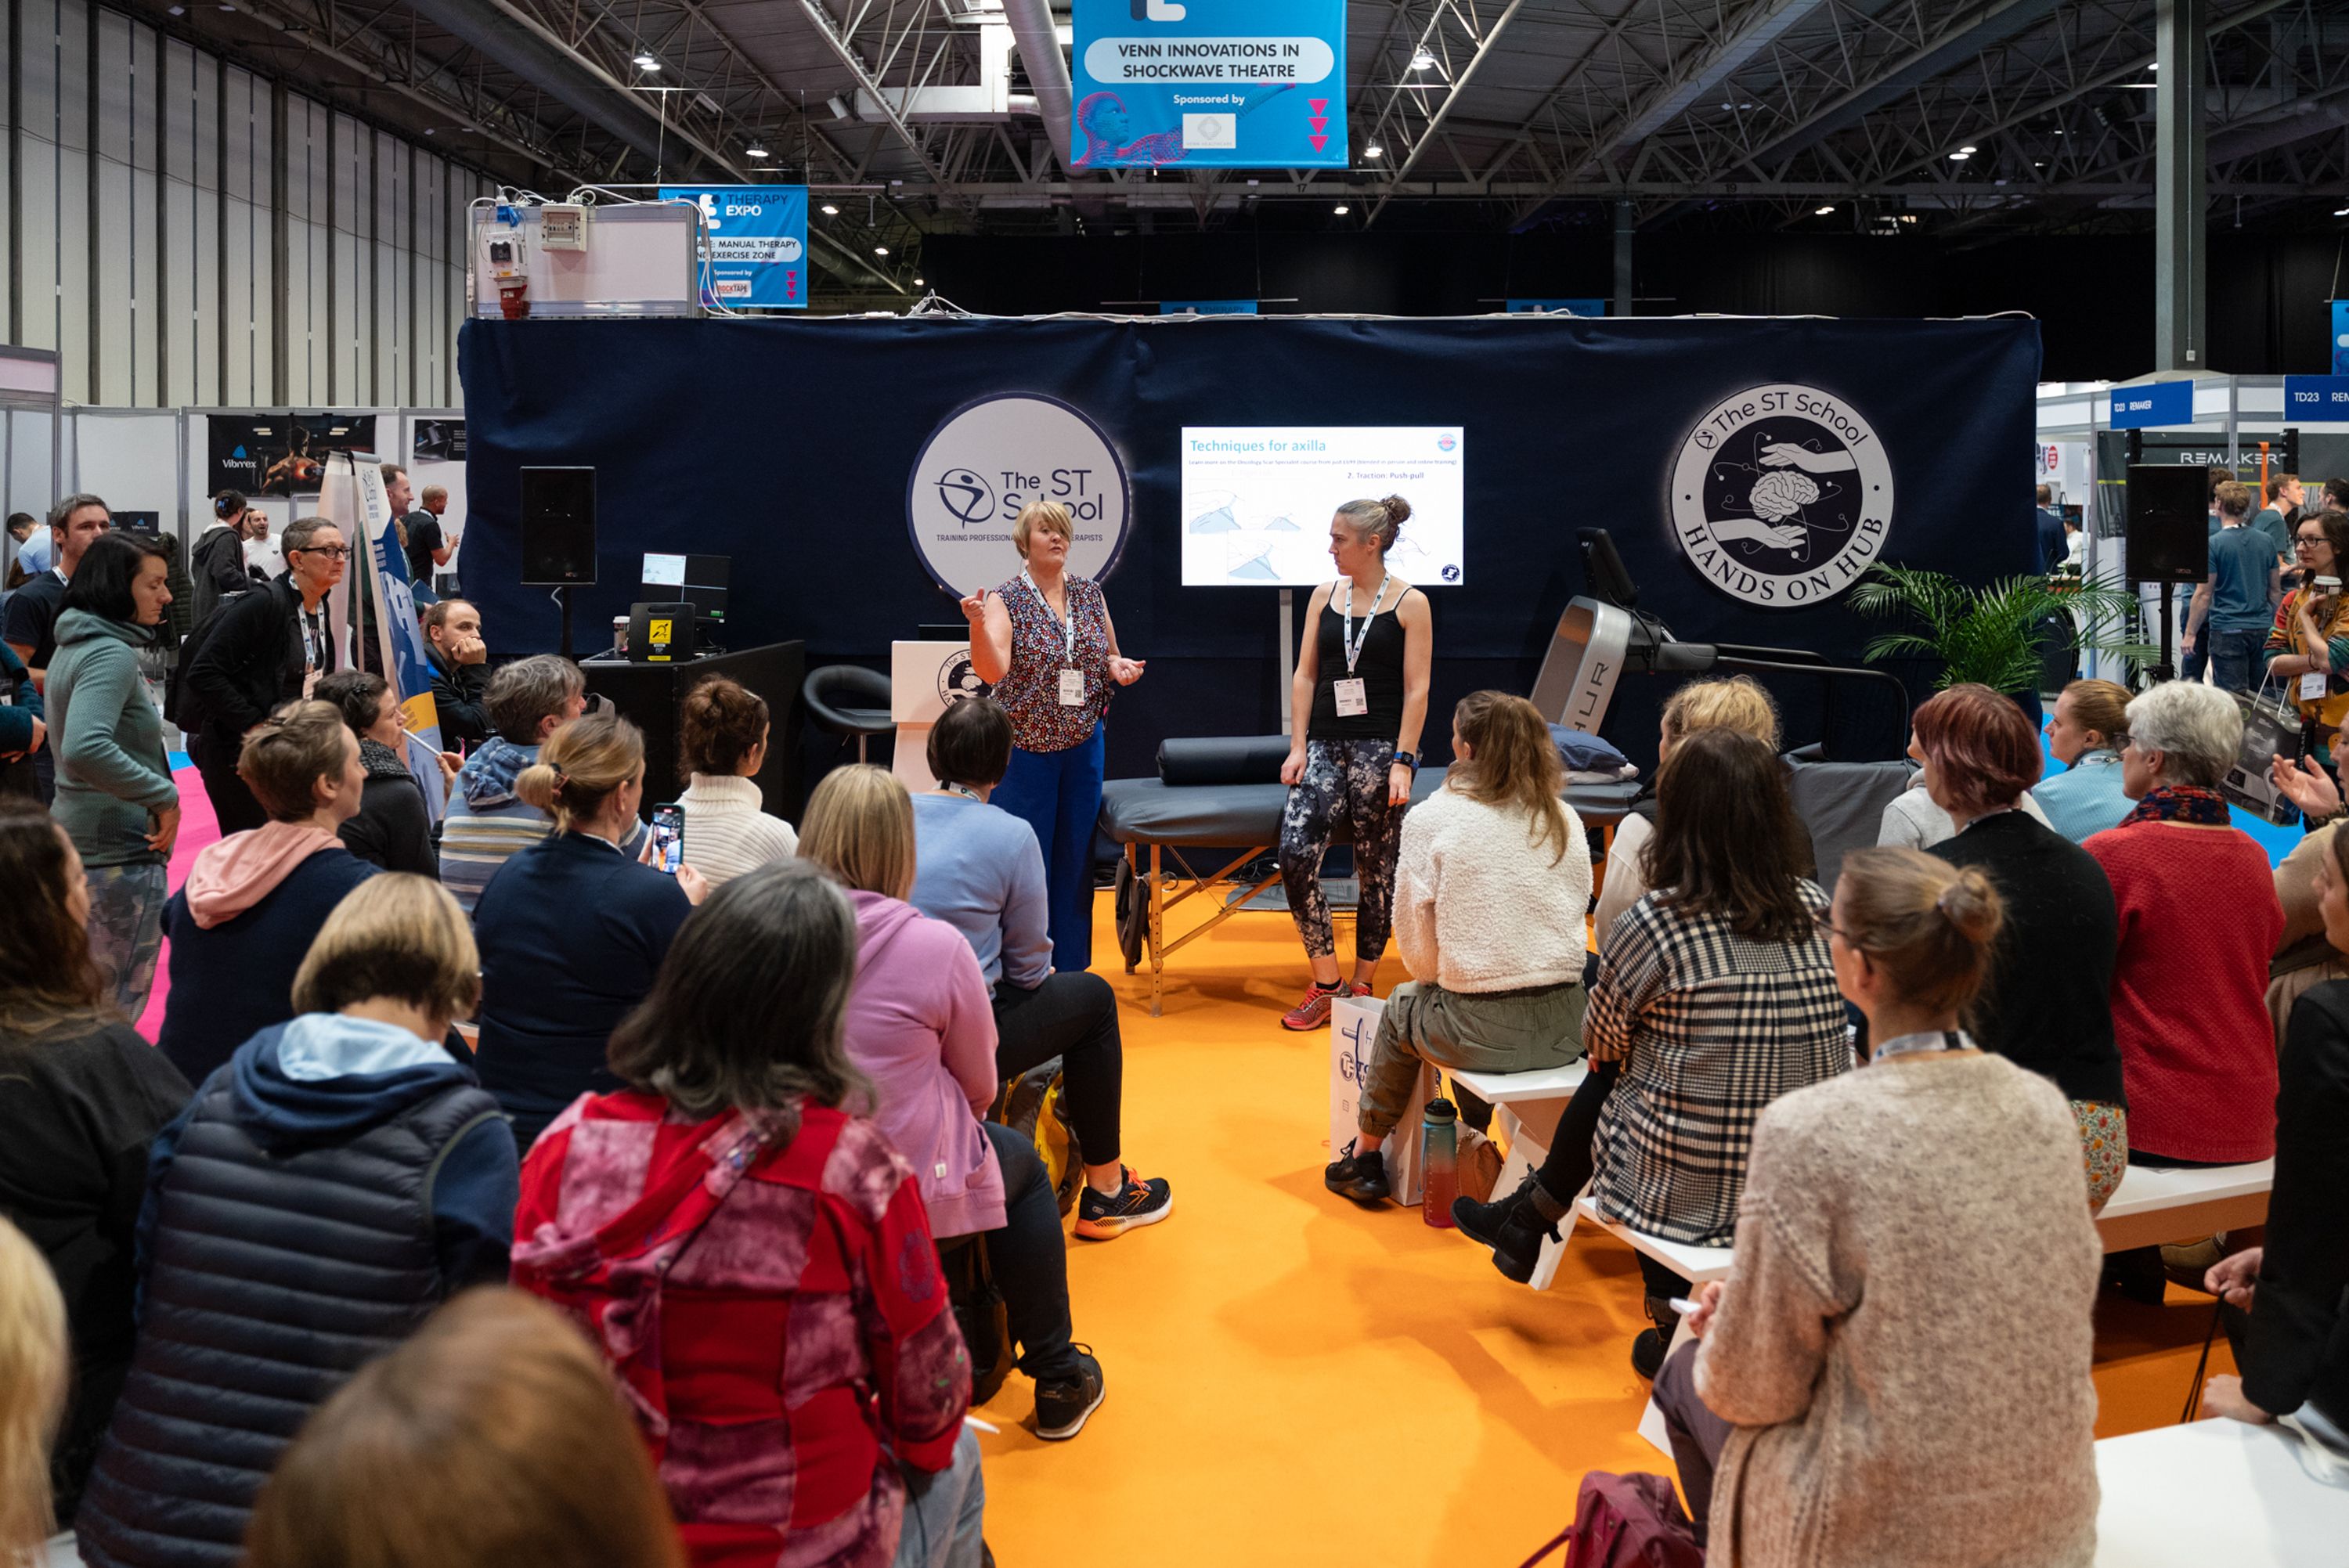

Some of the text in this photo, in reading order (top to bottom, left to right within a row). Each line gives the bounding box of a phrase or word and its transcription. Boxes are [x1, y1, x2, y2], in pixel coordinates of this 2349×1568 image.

[1118, 44, 1300, 57] VENN INNOVATIONS IN
[1123, 64, 1295, 77] SHOCKWAVE THEATRE
[1174, 94, 1245, 106] Sponsored by
[727, 194, 788, 204] THERAPY
[726, 205, 762, 216] EXPO
[2293, 392, 2319, 402] TD23
[2130, 400, 2152, 411] REMAKER
[1712, 392, 1868, 446] The ST School
[1190, 440, 1326, 453] Techniques for axilla
[1001, 469, 1092, 496] The ST
[1003, 493, 1102, 521] Sool
[1684, 517, 1883, 600] HANDS ON HUB
[944, 657, 958, 669] The
